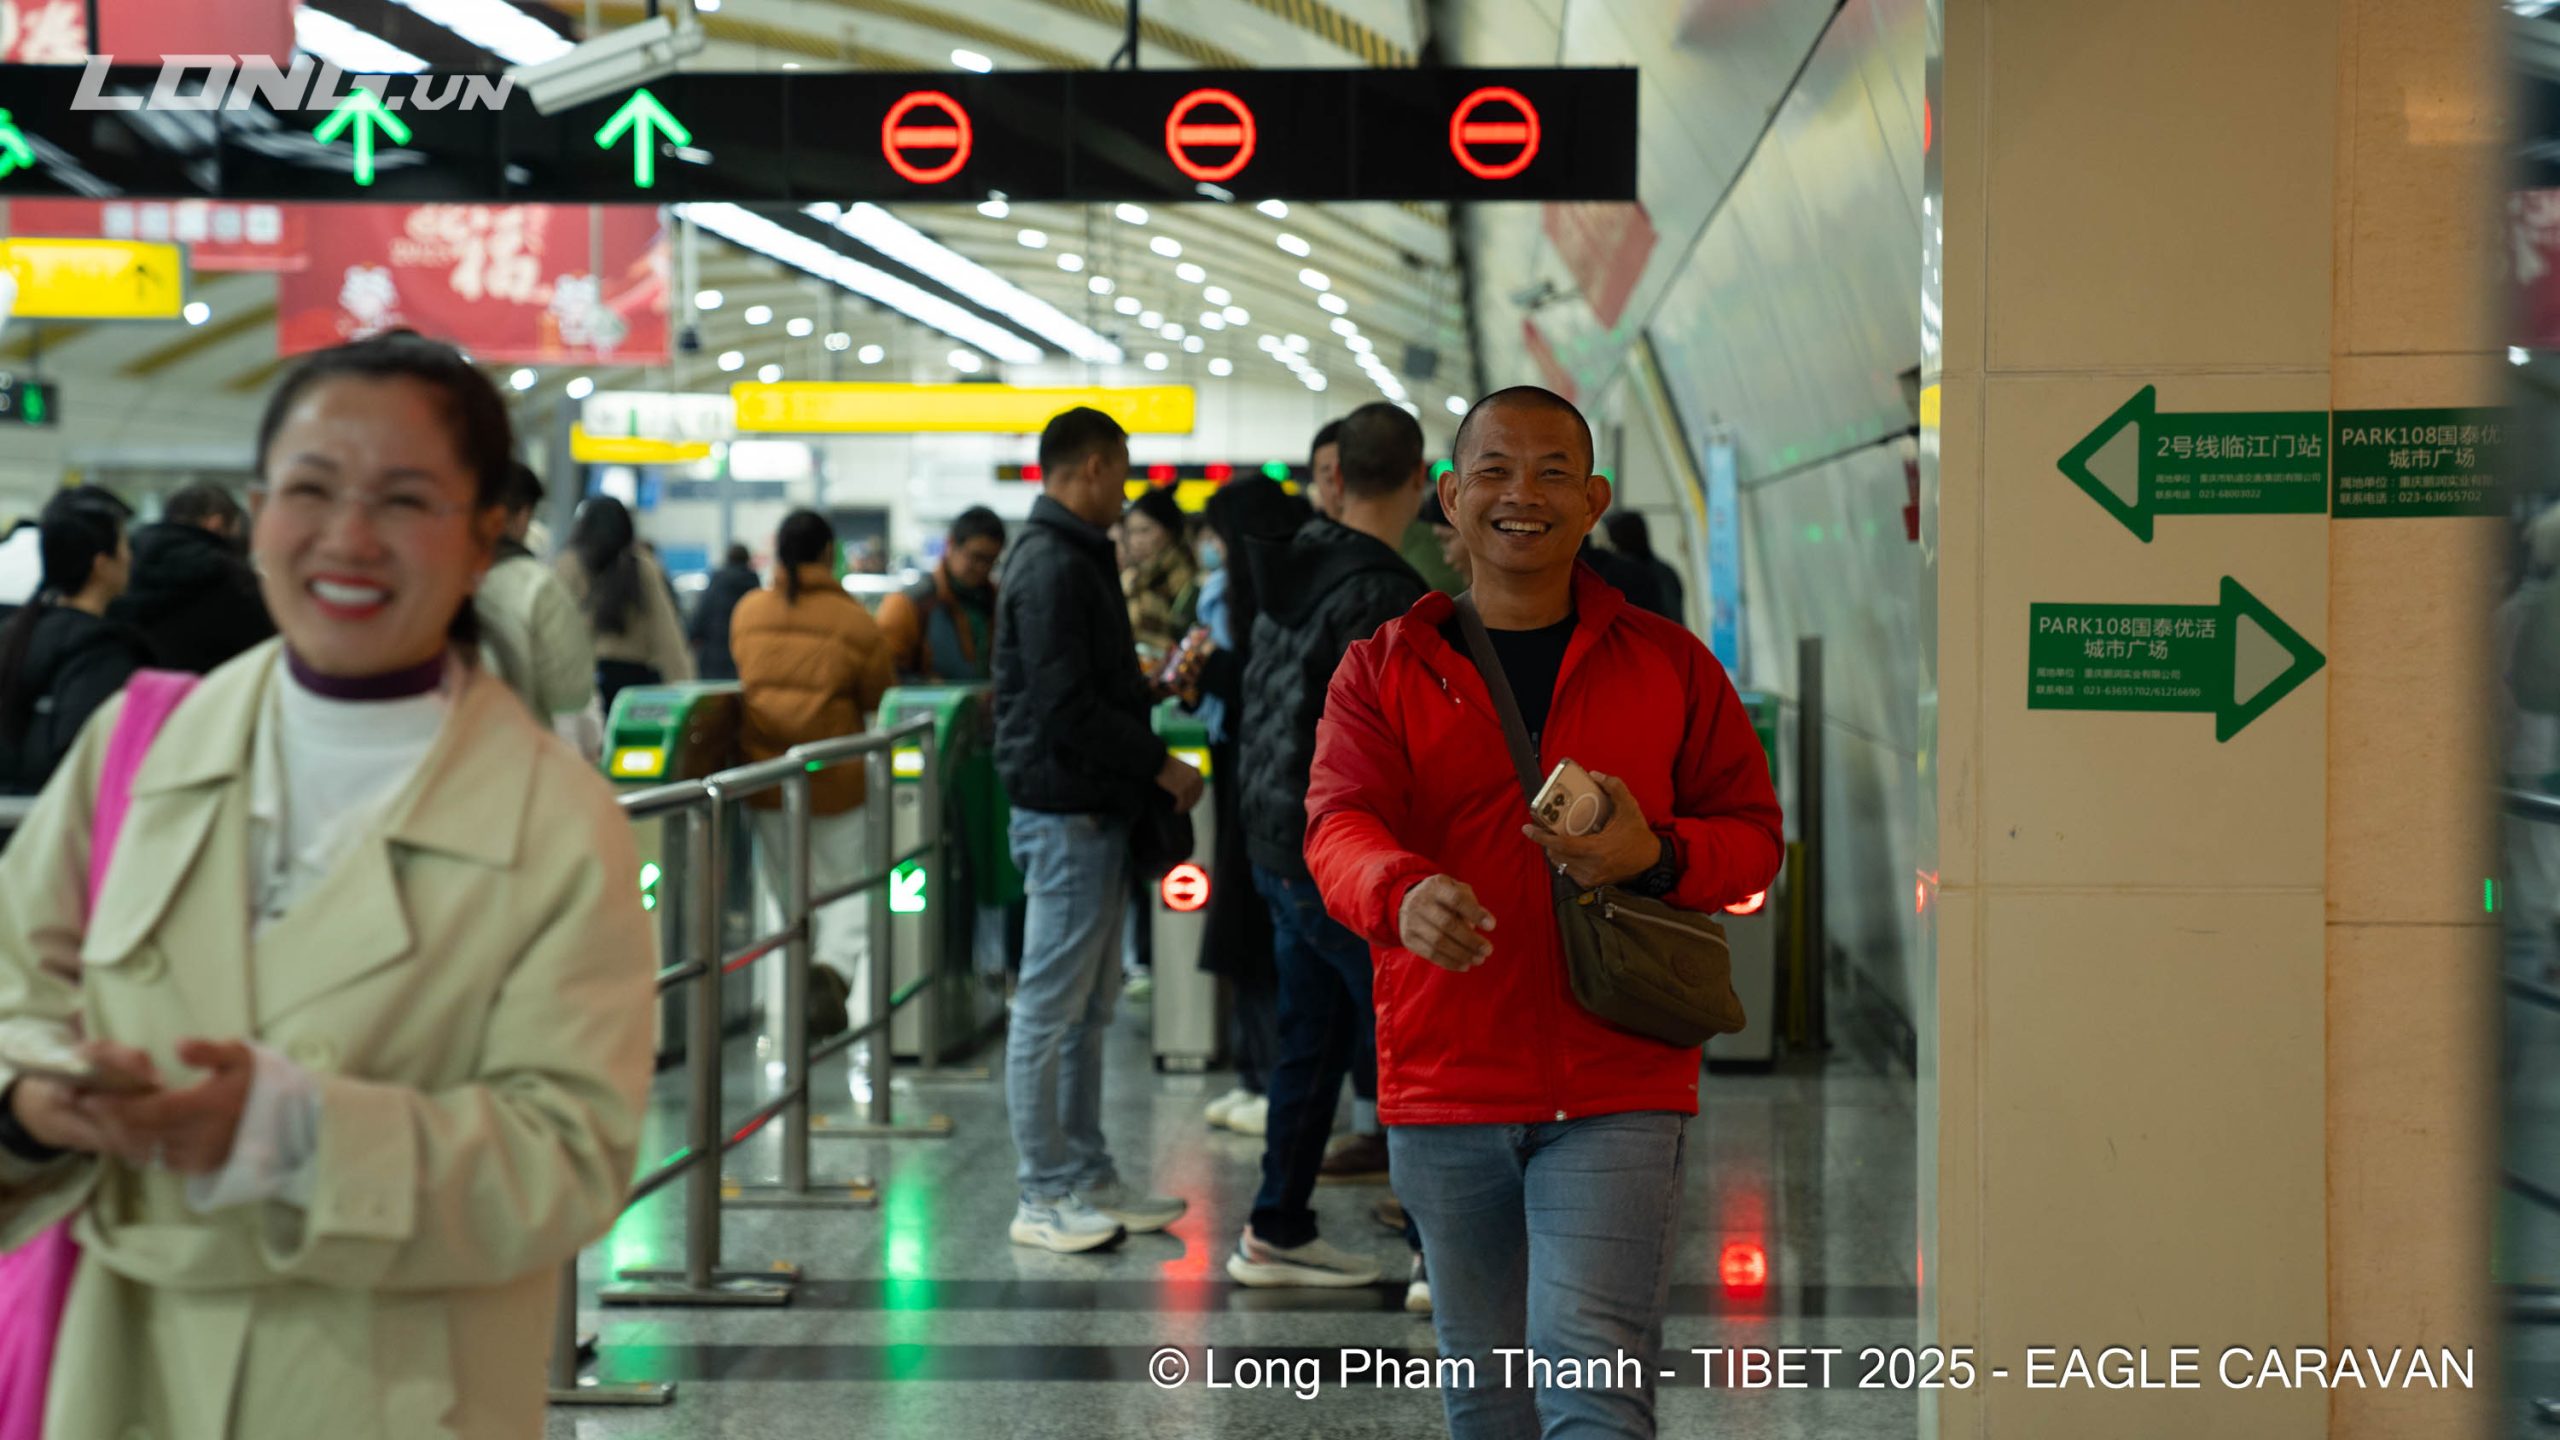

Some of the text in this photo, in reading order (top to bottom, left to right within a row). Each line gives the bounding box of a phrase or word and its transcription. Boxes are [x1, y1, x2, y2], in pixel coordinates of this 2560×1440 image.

[2156, 433, 2322, 459] 2号线临江门站
[2388, 447, 2476, 469] 城市广场
[2039, 616, 2216, 639] PARK108国泰优活
[2083, 639, 2169, 660] 城市广场
